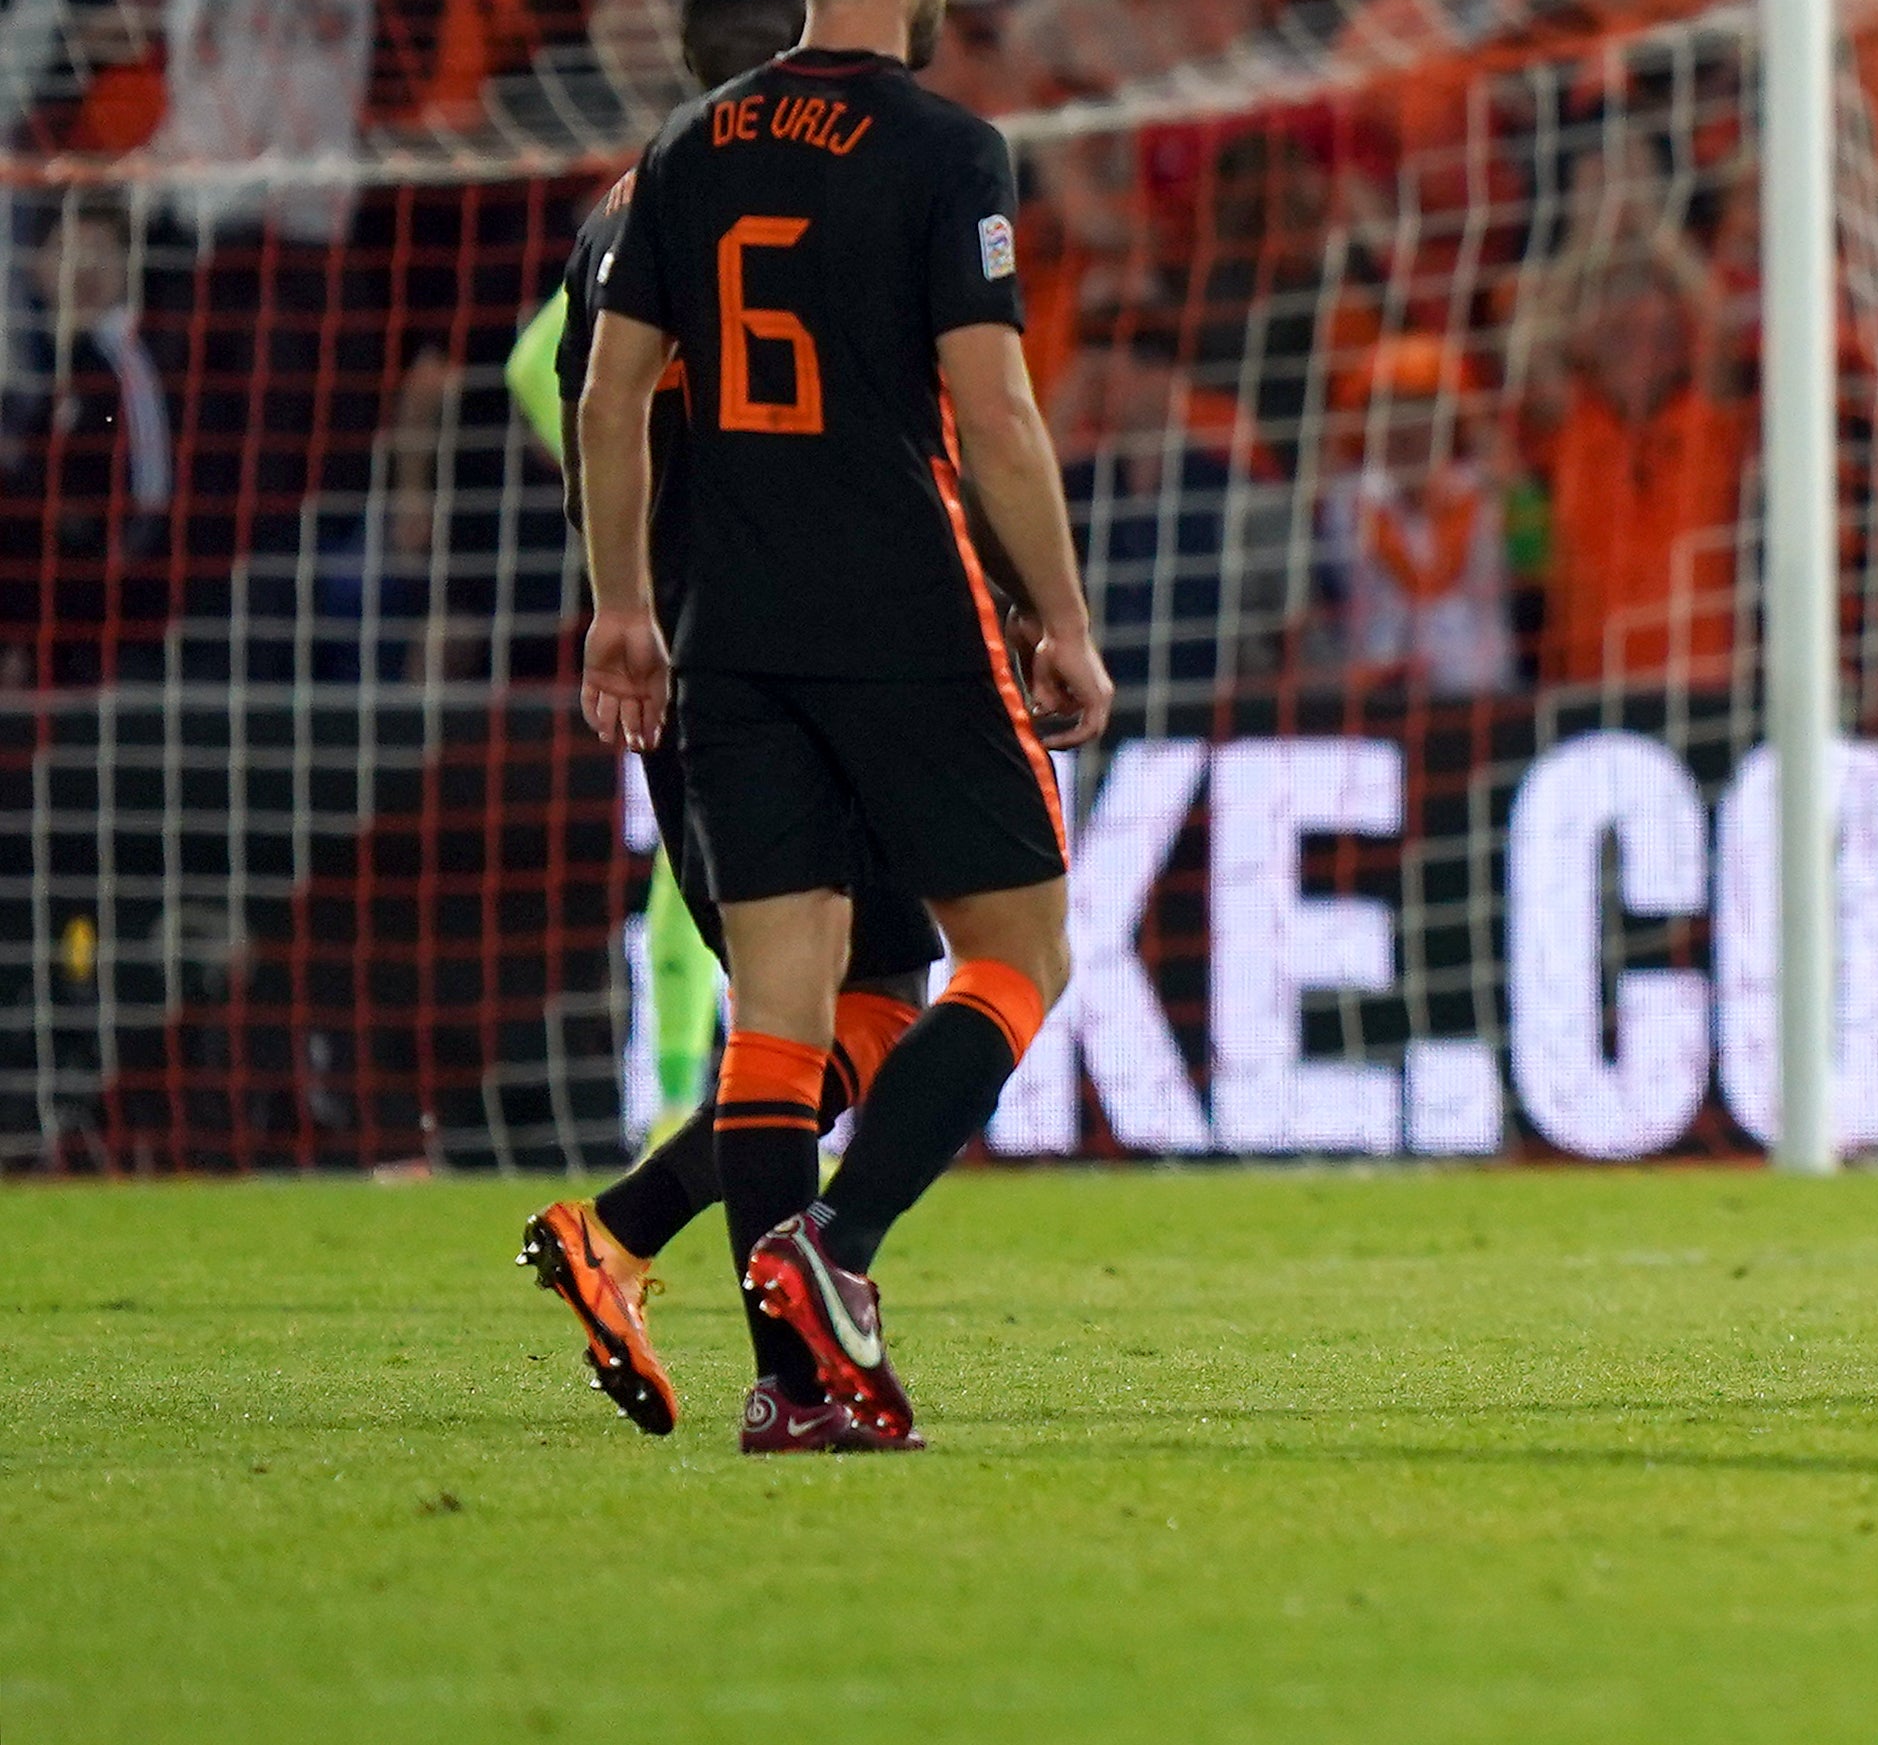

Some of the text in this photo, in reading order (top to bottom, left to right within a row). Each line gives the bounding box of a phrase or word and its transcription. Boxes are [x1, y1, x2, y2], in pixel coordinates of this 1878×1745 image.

[711, 95, 874, 156] DE VRIJ
[717, 214, 825, 434] 6
